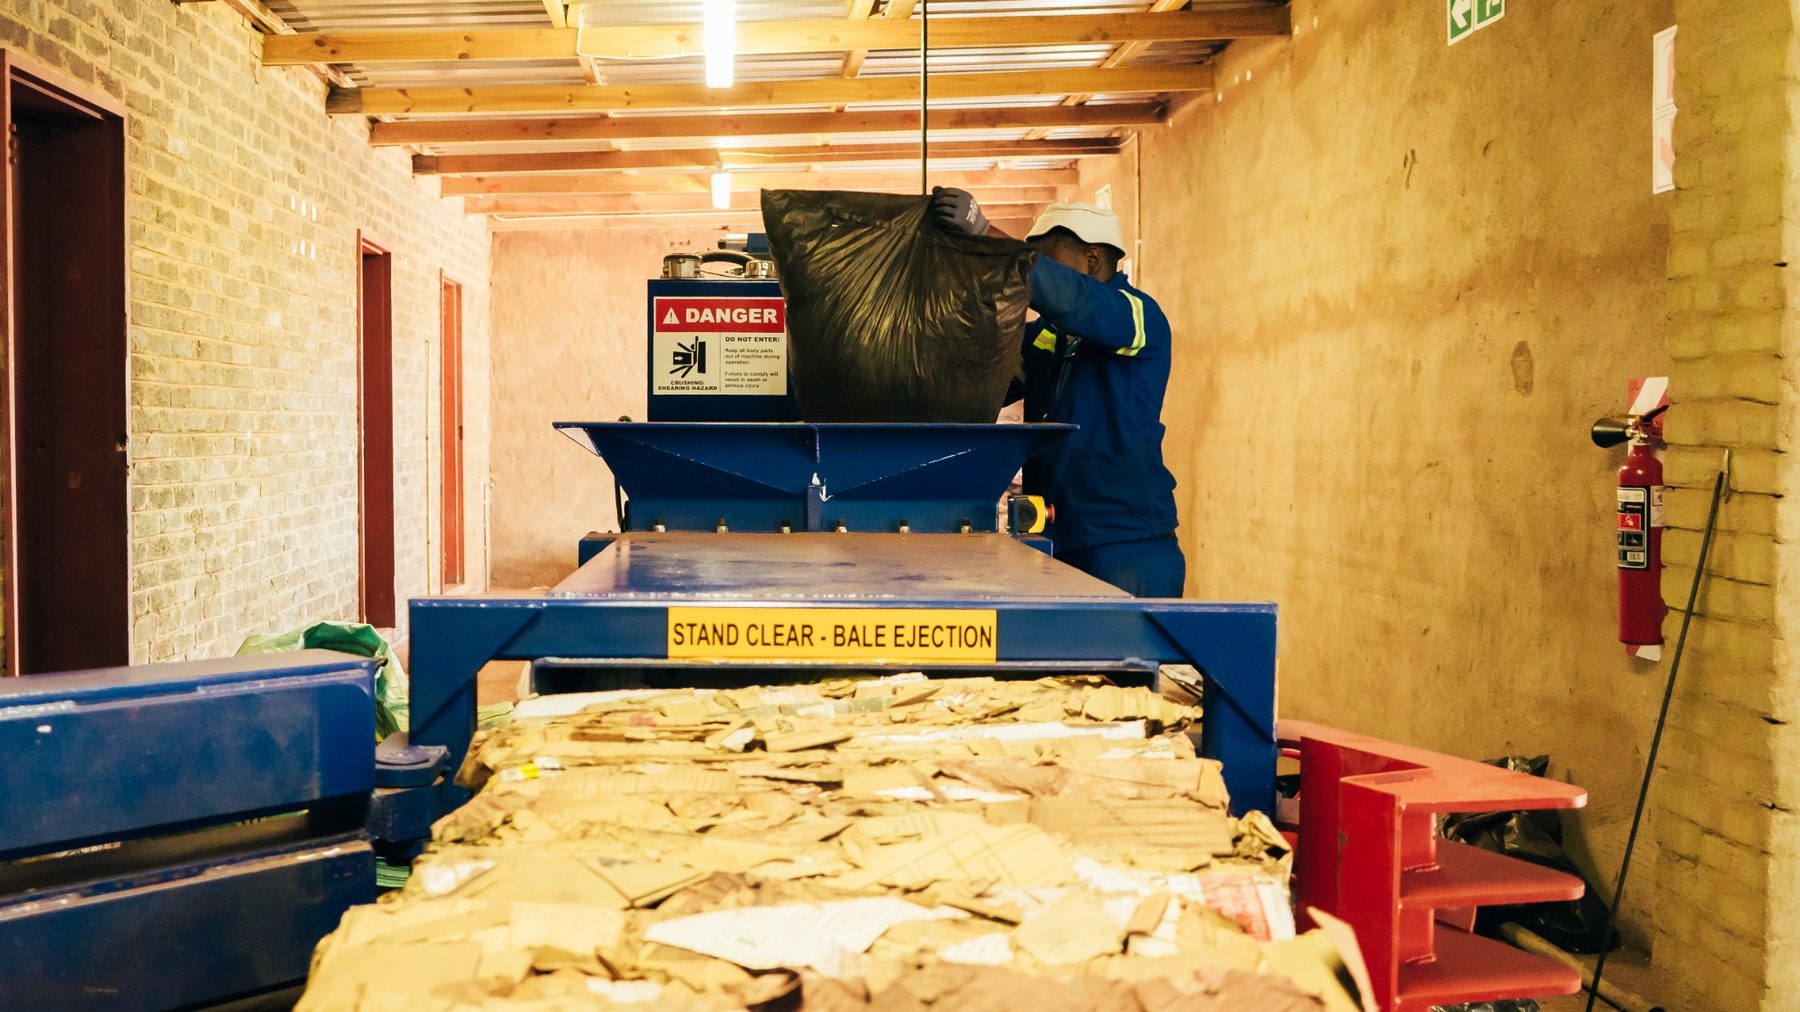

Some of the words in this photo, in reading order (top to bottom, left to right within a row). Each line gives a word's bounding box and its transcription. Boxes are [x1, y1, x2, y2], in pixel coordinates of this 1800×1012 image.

[685, 308, 778, 324] DANGER
[673, 623, 739, 646] STAND
[746, 624, 814, 647] CLEAR
[834, 624, 886, 648] BALE
[894, 625, 992, 648] EJECTION
